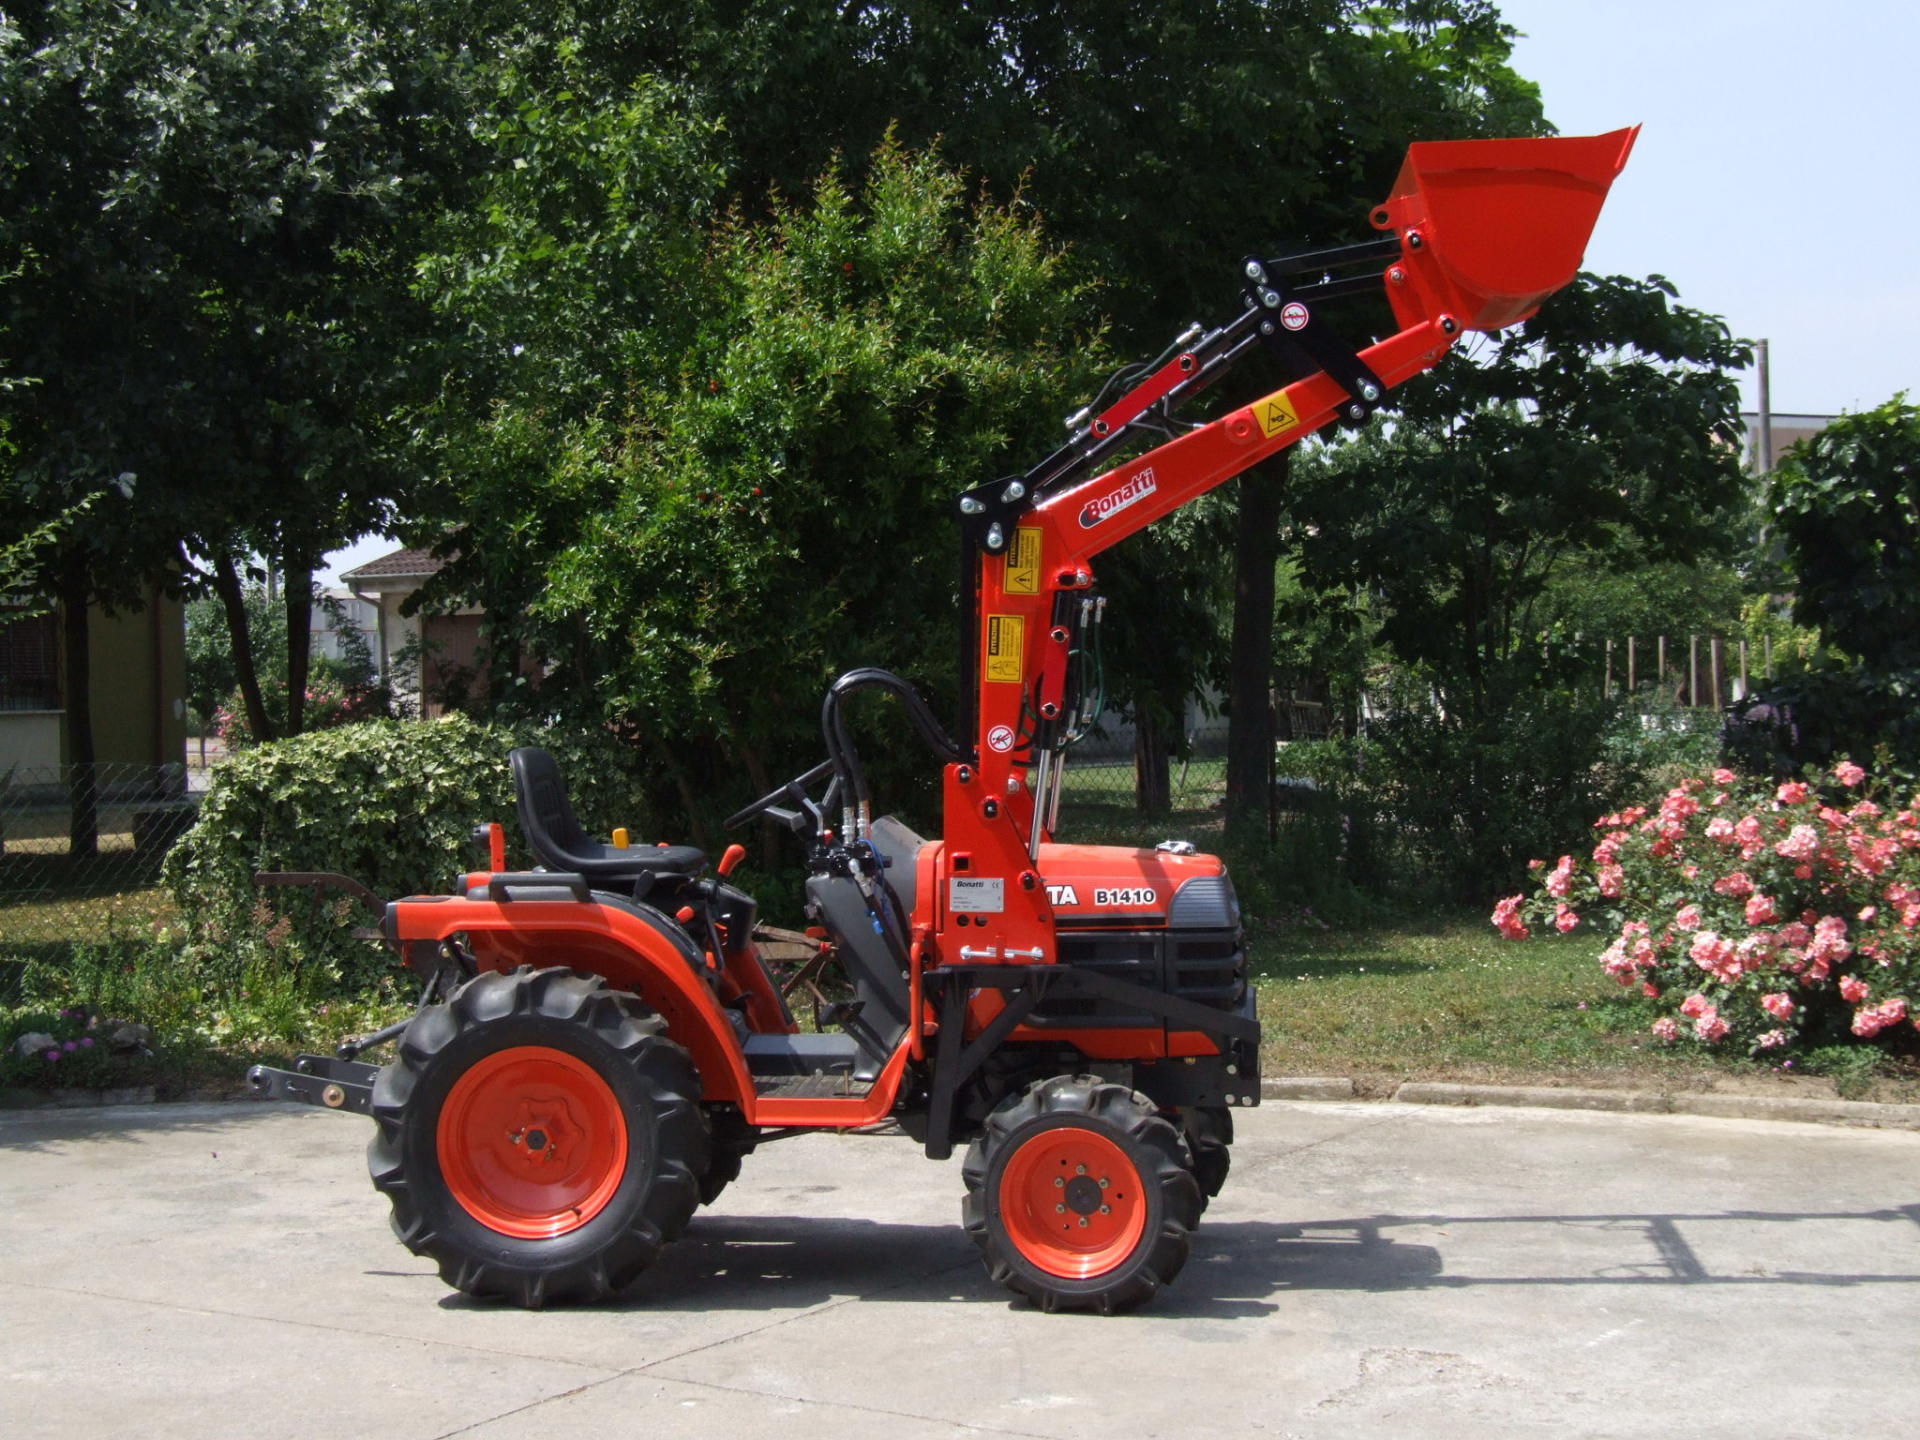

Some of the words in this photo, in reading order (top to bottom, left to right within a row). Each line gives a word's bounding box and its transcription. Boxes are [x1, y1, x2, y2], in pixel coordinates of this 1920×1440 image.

[1086, 468, 1154, 520] Bonatti
[957, 880, 984, 888] Bonatti
[1095, 888, 1156, 905] B1410
